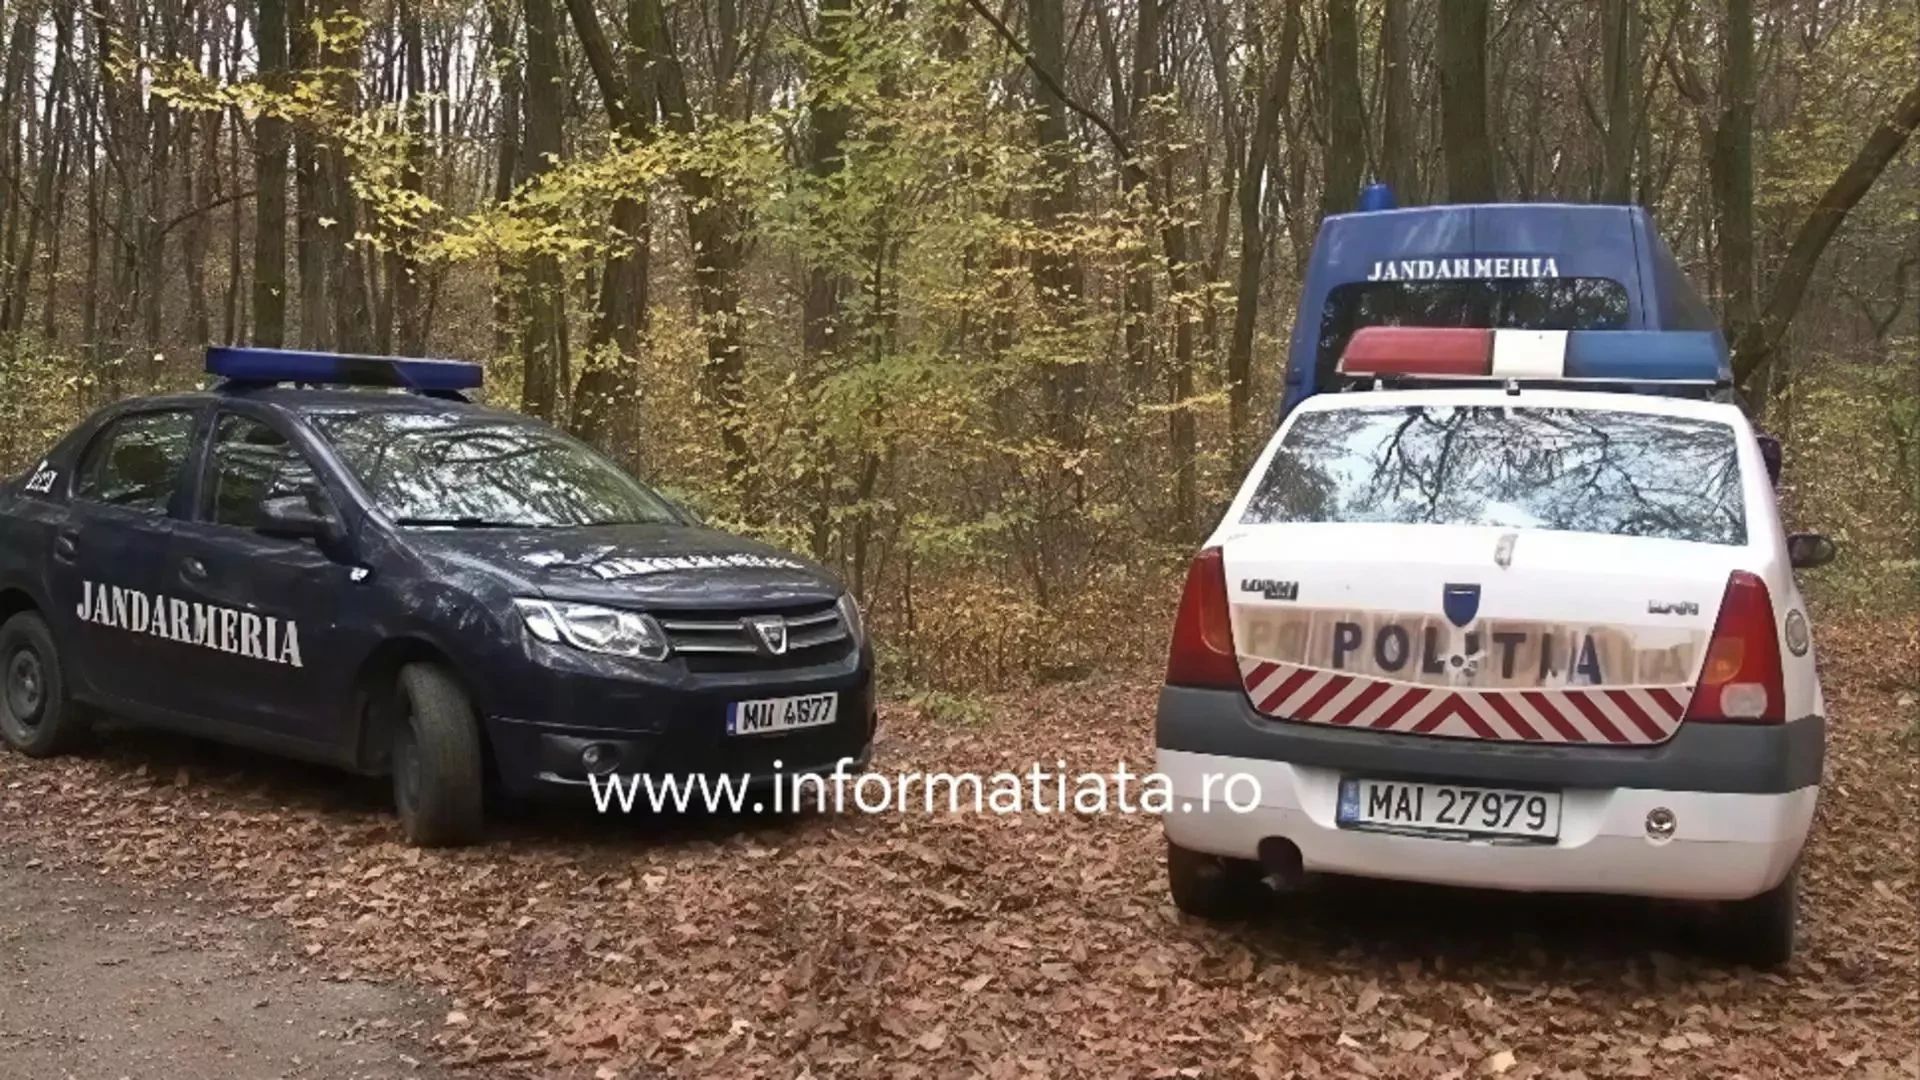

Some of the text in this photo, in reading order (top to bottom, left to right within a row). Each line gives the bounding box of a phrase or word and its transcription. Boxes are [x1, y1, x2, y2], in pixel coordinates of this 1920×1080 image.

[1367, 257, 1560, 281] JANDARMERIA
[76, 580, 303, 667] JANDARMERIA
[1367, 784, 1548, 831] MAI 27979
